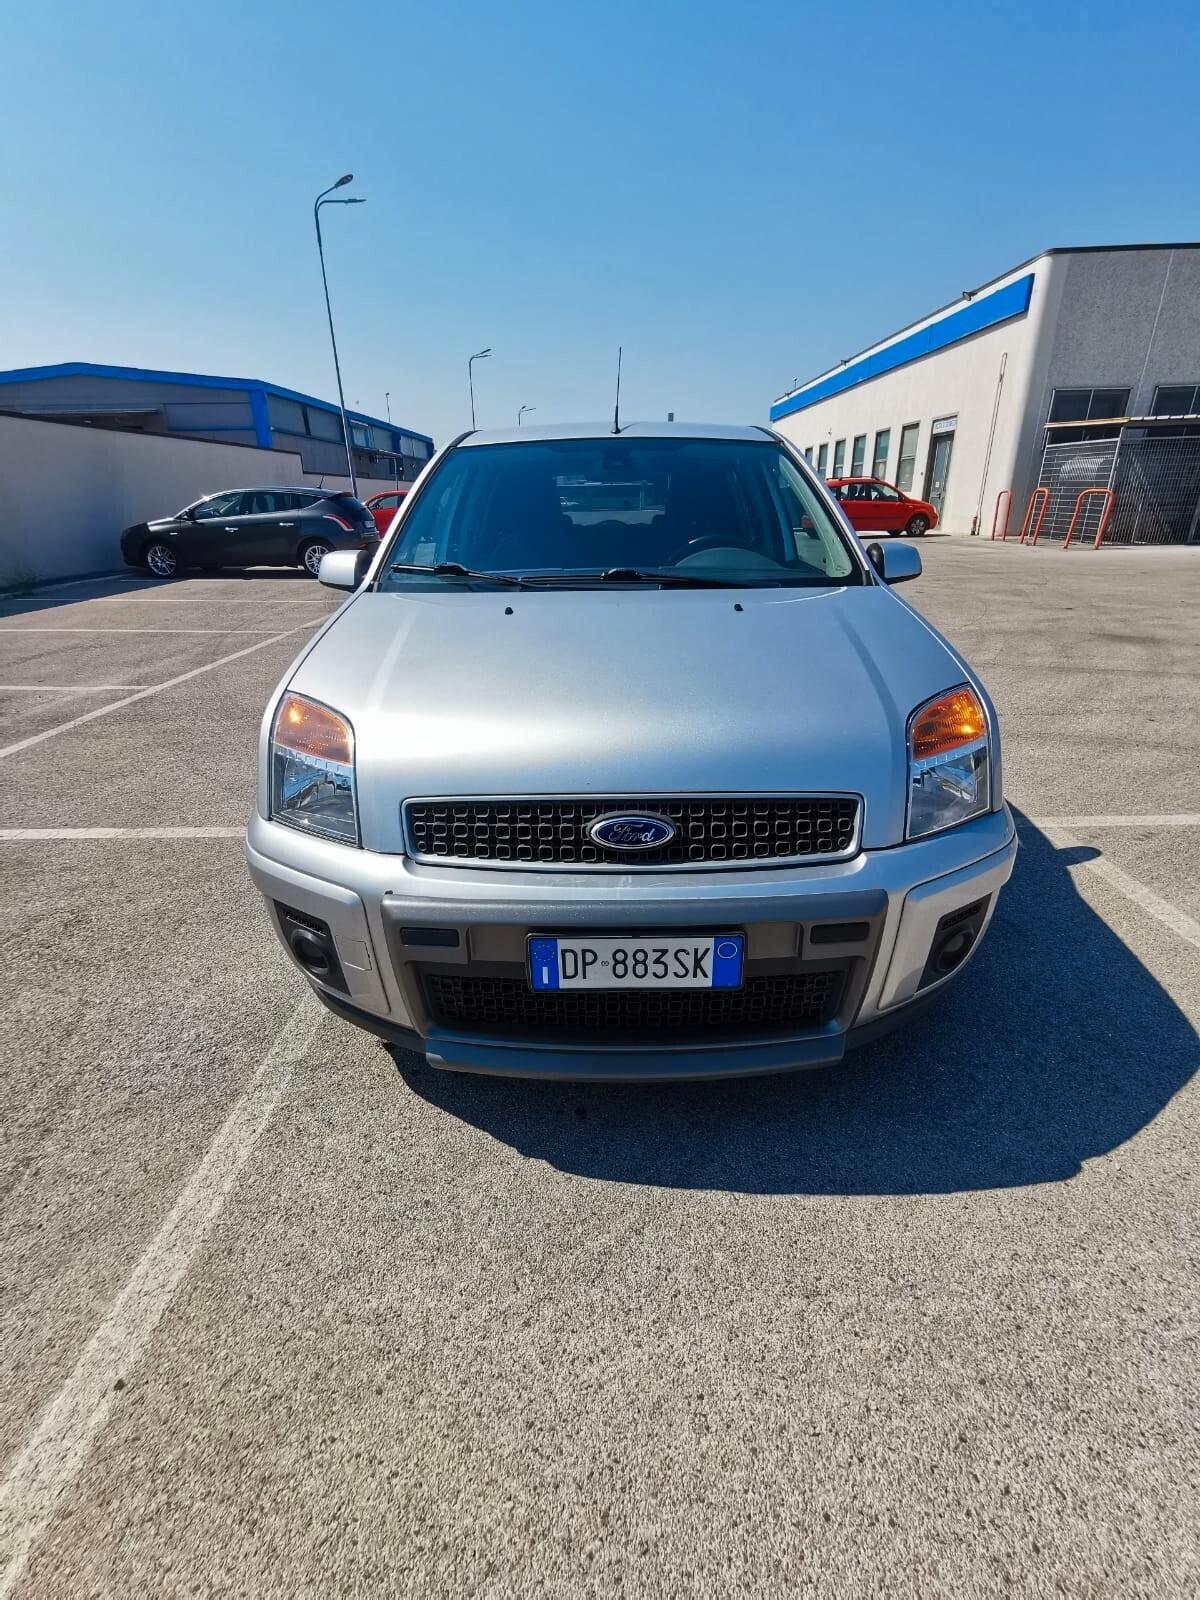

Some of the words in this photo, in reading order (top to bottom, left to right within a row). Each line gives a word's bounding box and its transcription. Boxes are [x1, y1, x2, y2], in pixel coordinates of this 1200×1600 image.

[608, 823, 655, 842] Ford
[561, 948, 598, 979] DP
[611, 947, 710, 979] 883SK
[542, 966, 549, 984] I
